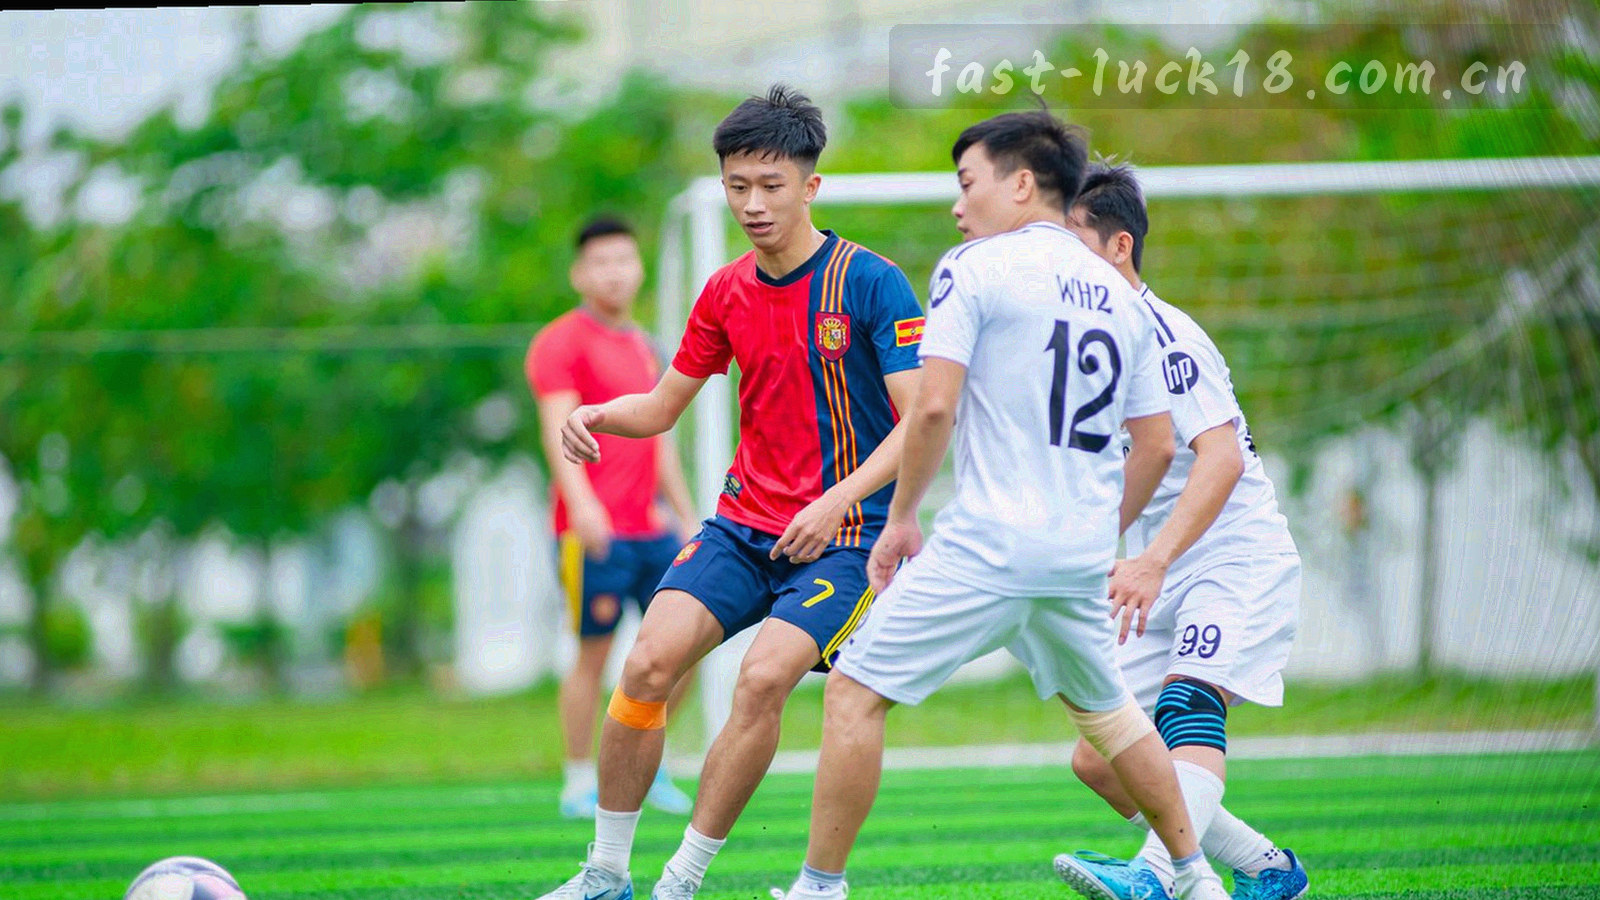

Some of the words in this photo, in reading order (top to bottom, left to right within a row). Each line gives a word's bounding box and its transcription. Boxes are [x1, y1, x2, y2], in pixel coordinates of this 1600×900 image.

[1056, 274, 1112, 315] WH2
[1044, 319, 1122, 454] 12
[1163, 353, 1197, 393] hp
[802, 578, 835, 608] 7
[1178, 623, 1222, 659] 99
